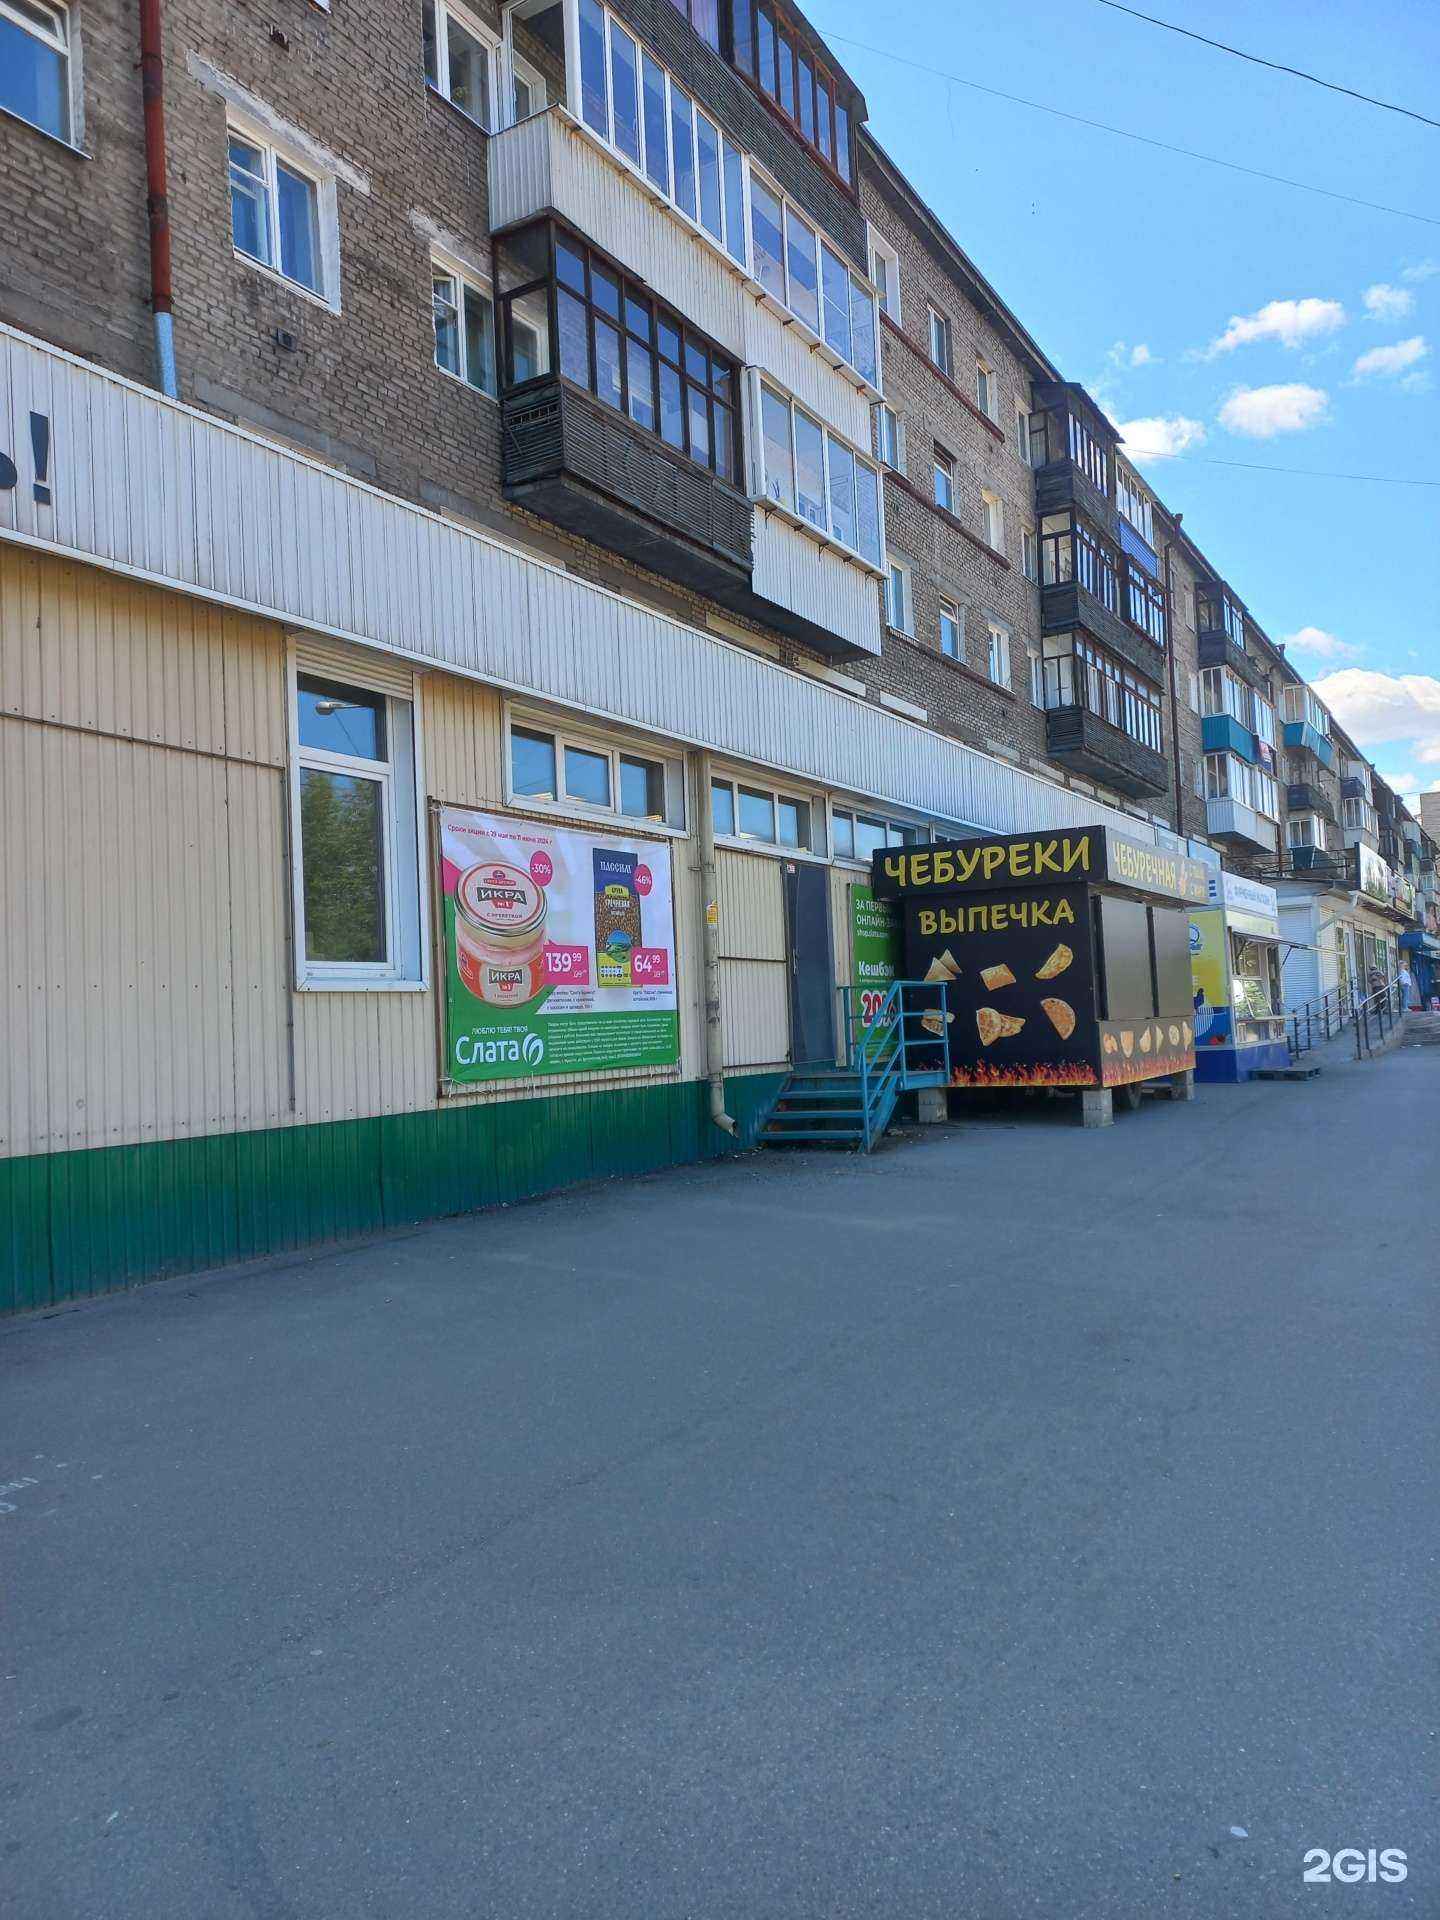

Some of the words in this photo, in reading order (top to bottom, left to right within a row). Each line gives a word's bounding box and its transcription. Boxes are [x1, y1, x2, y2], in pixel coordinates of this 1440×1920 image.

[532, 863, 552, 876] -30%
[884, 835, 1090, 887] ЧЕБУРЕКИ
[1112, 841, 1177, 890] ЧЕБУРЕЧНАЯ
[480, 889, 525, 902] ИКРА
[855, 899, 865, 911] ЗА
[865, 900, 889, 914] ПЕРВЫ
[918, 898, 1075, 935] ВЫПЕЧКА
[545, 952, 572, 972] 139
[572, 952, 582, 962] 99
[634, 955, 652, 973] 64
[652, 954, 661, 964] 99
[858, 960, 894, 977] Кешбэк
[491, 971, 521, 981] ИКРА
[456, 1036, 520, 1065] Слата
